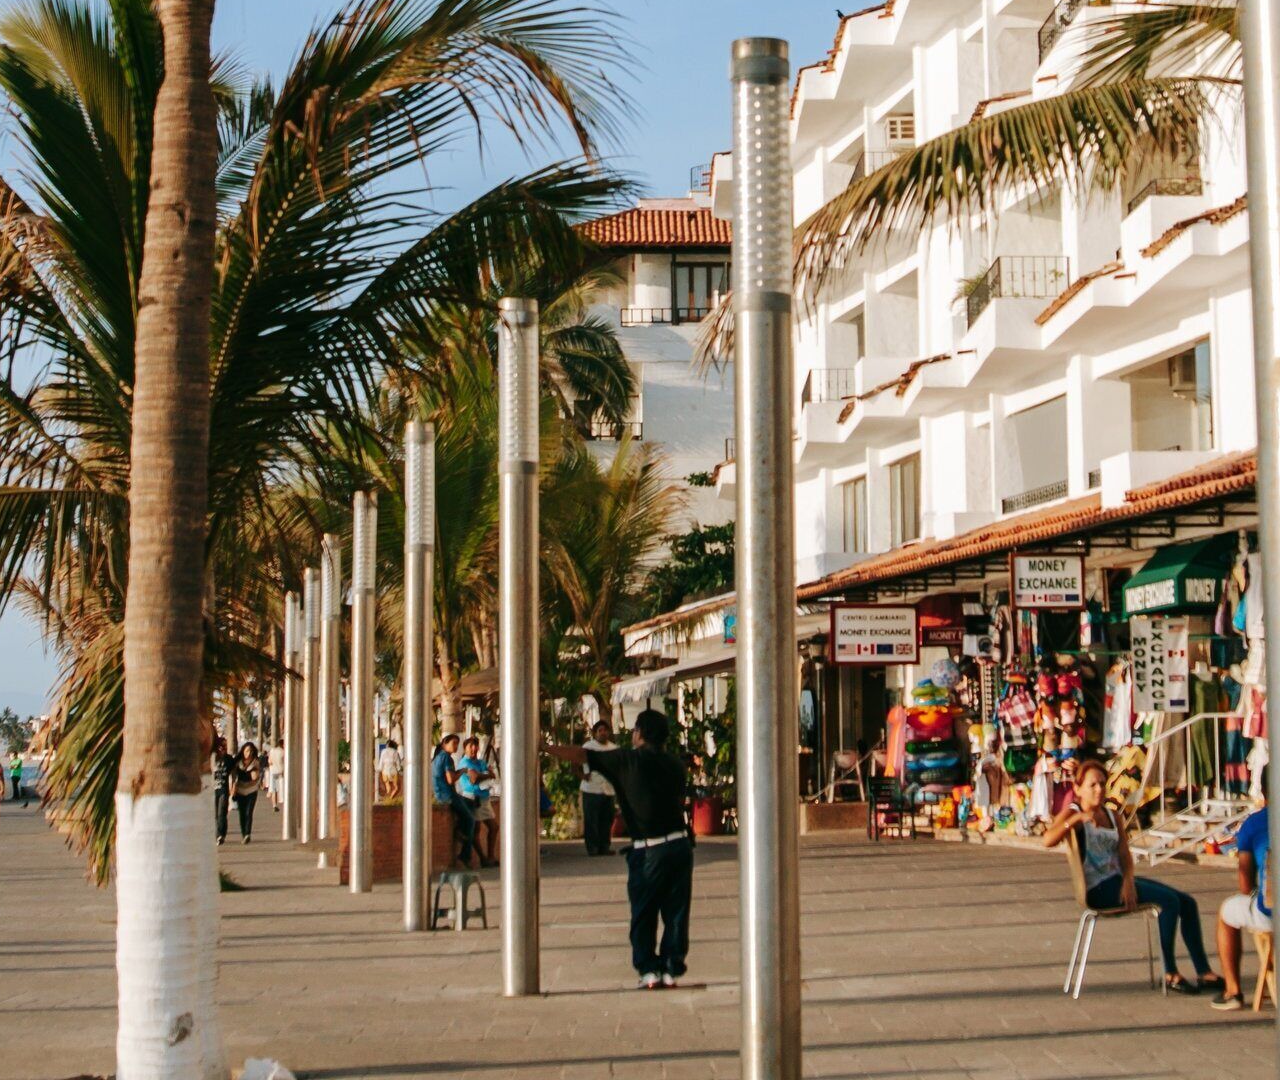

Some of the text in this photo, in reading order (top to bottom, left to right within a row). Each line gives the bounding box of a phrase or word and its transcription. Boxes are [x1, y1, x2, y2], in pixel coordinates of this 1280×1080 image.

[1028, 559, 1067, 572] MONEY
[1018, 577, 1078, 589] EXCHANGE
[1185, 578, 1216, 603] MONEY
[840, 628, 911, 637] MONEY EXCHANGE
[929, 631, 956, 640] MONEY
[1133, 637, 1147, 693] MONEY
[1150, 620, 1165, 711] EXCHANGE
